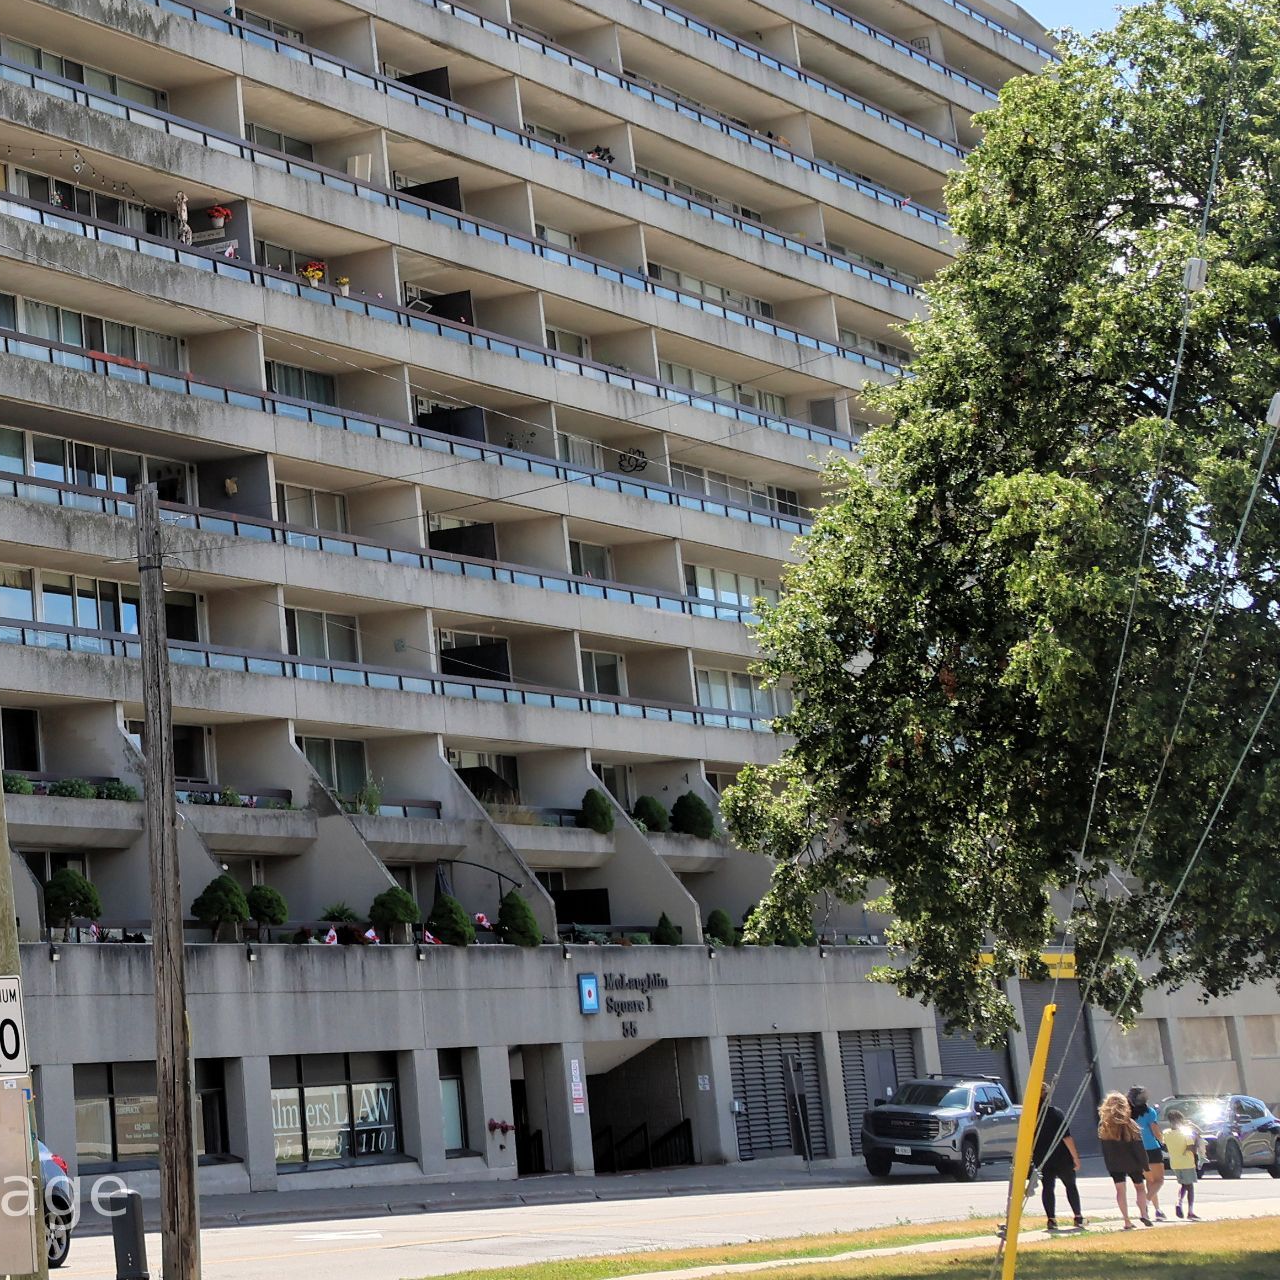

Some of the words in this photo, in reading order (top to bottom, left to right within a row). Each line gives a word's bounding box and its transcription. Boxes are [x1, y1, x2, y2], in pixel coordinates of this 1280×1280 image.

[604, 972, 669, 994] McLaughlin
[606, 995, 645, 1017] Square
[622, 1021, 638, 1038] 55
